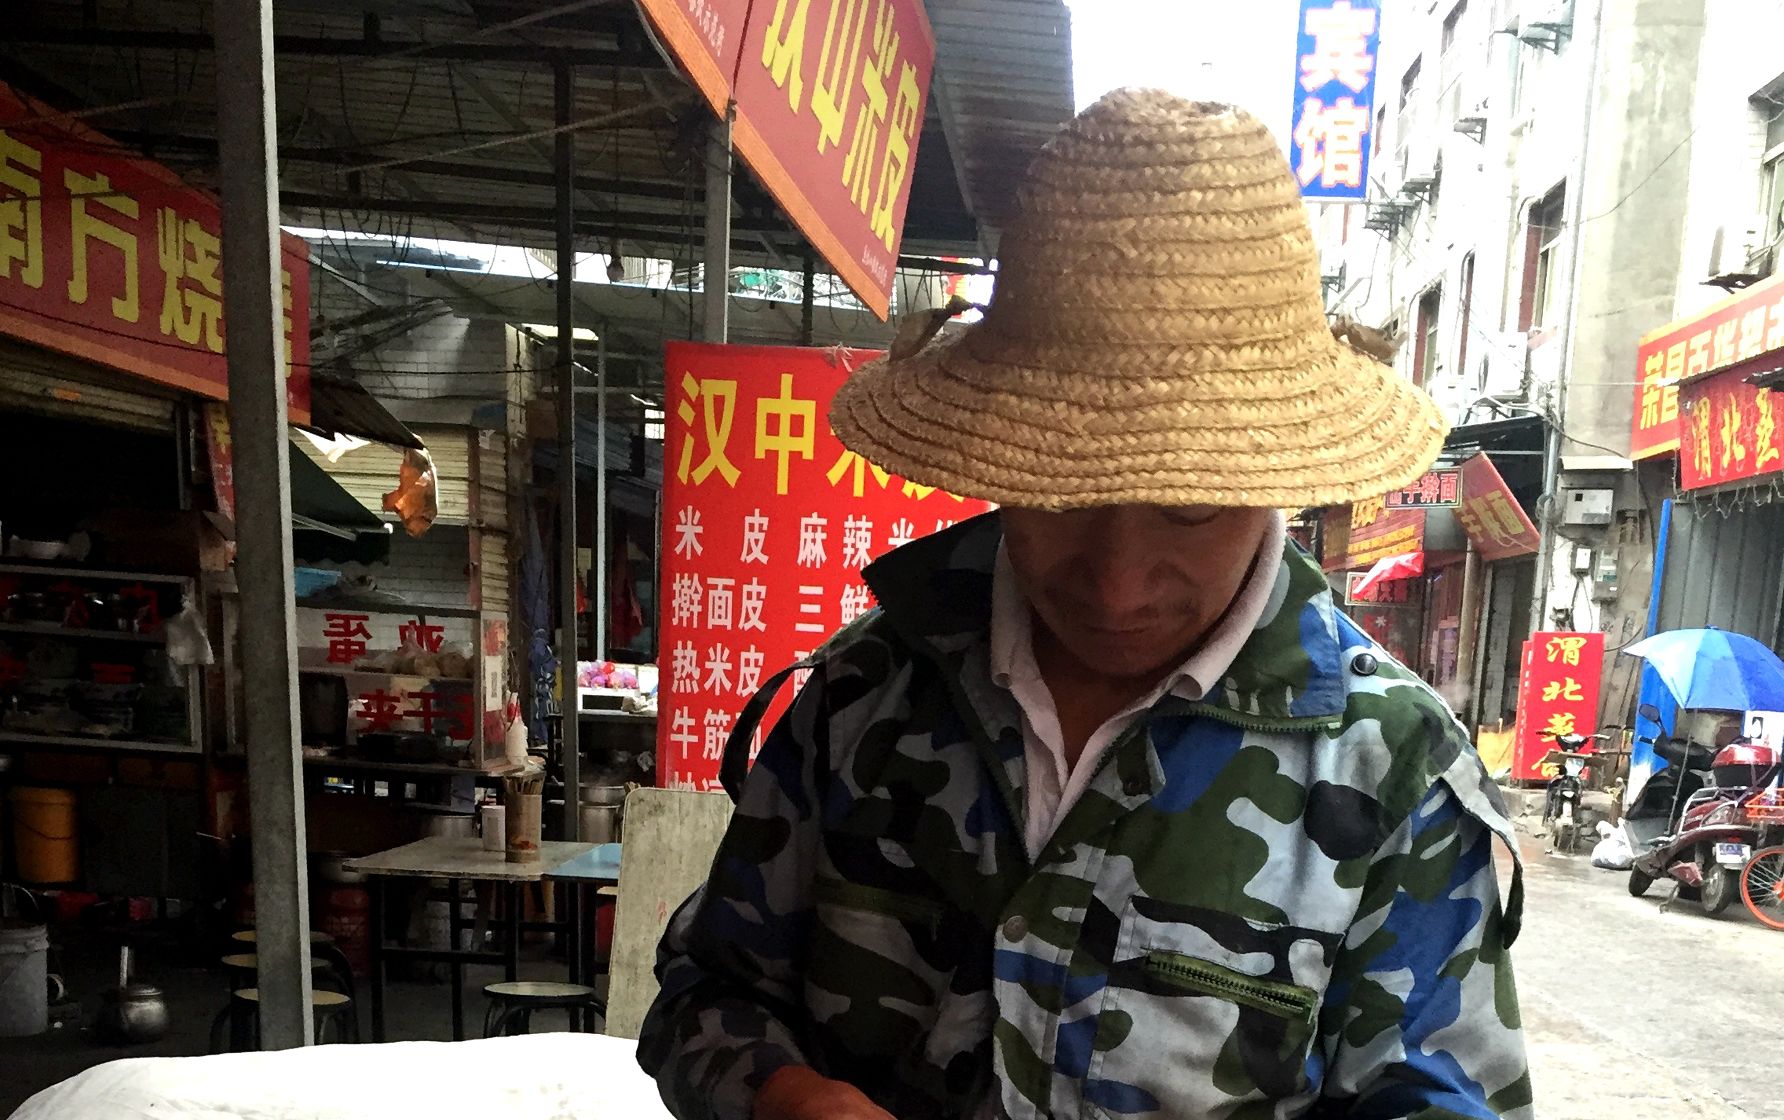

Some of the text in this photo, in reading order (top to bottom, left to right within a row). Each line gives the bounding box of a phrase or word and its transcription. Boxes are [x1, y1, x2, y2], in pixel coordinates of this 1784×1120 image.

[1293, 1, 1376, 187] 宾馆
[0, 130, 293, 378] 南方烧
[676, 370, 964, 503] 汉中
[675, 504, 958, 570] 米皮 麻辣米
[672, 572, 767, 632] 擀面皮
[671, 640, 764, 697] 热米皮
